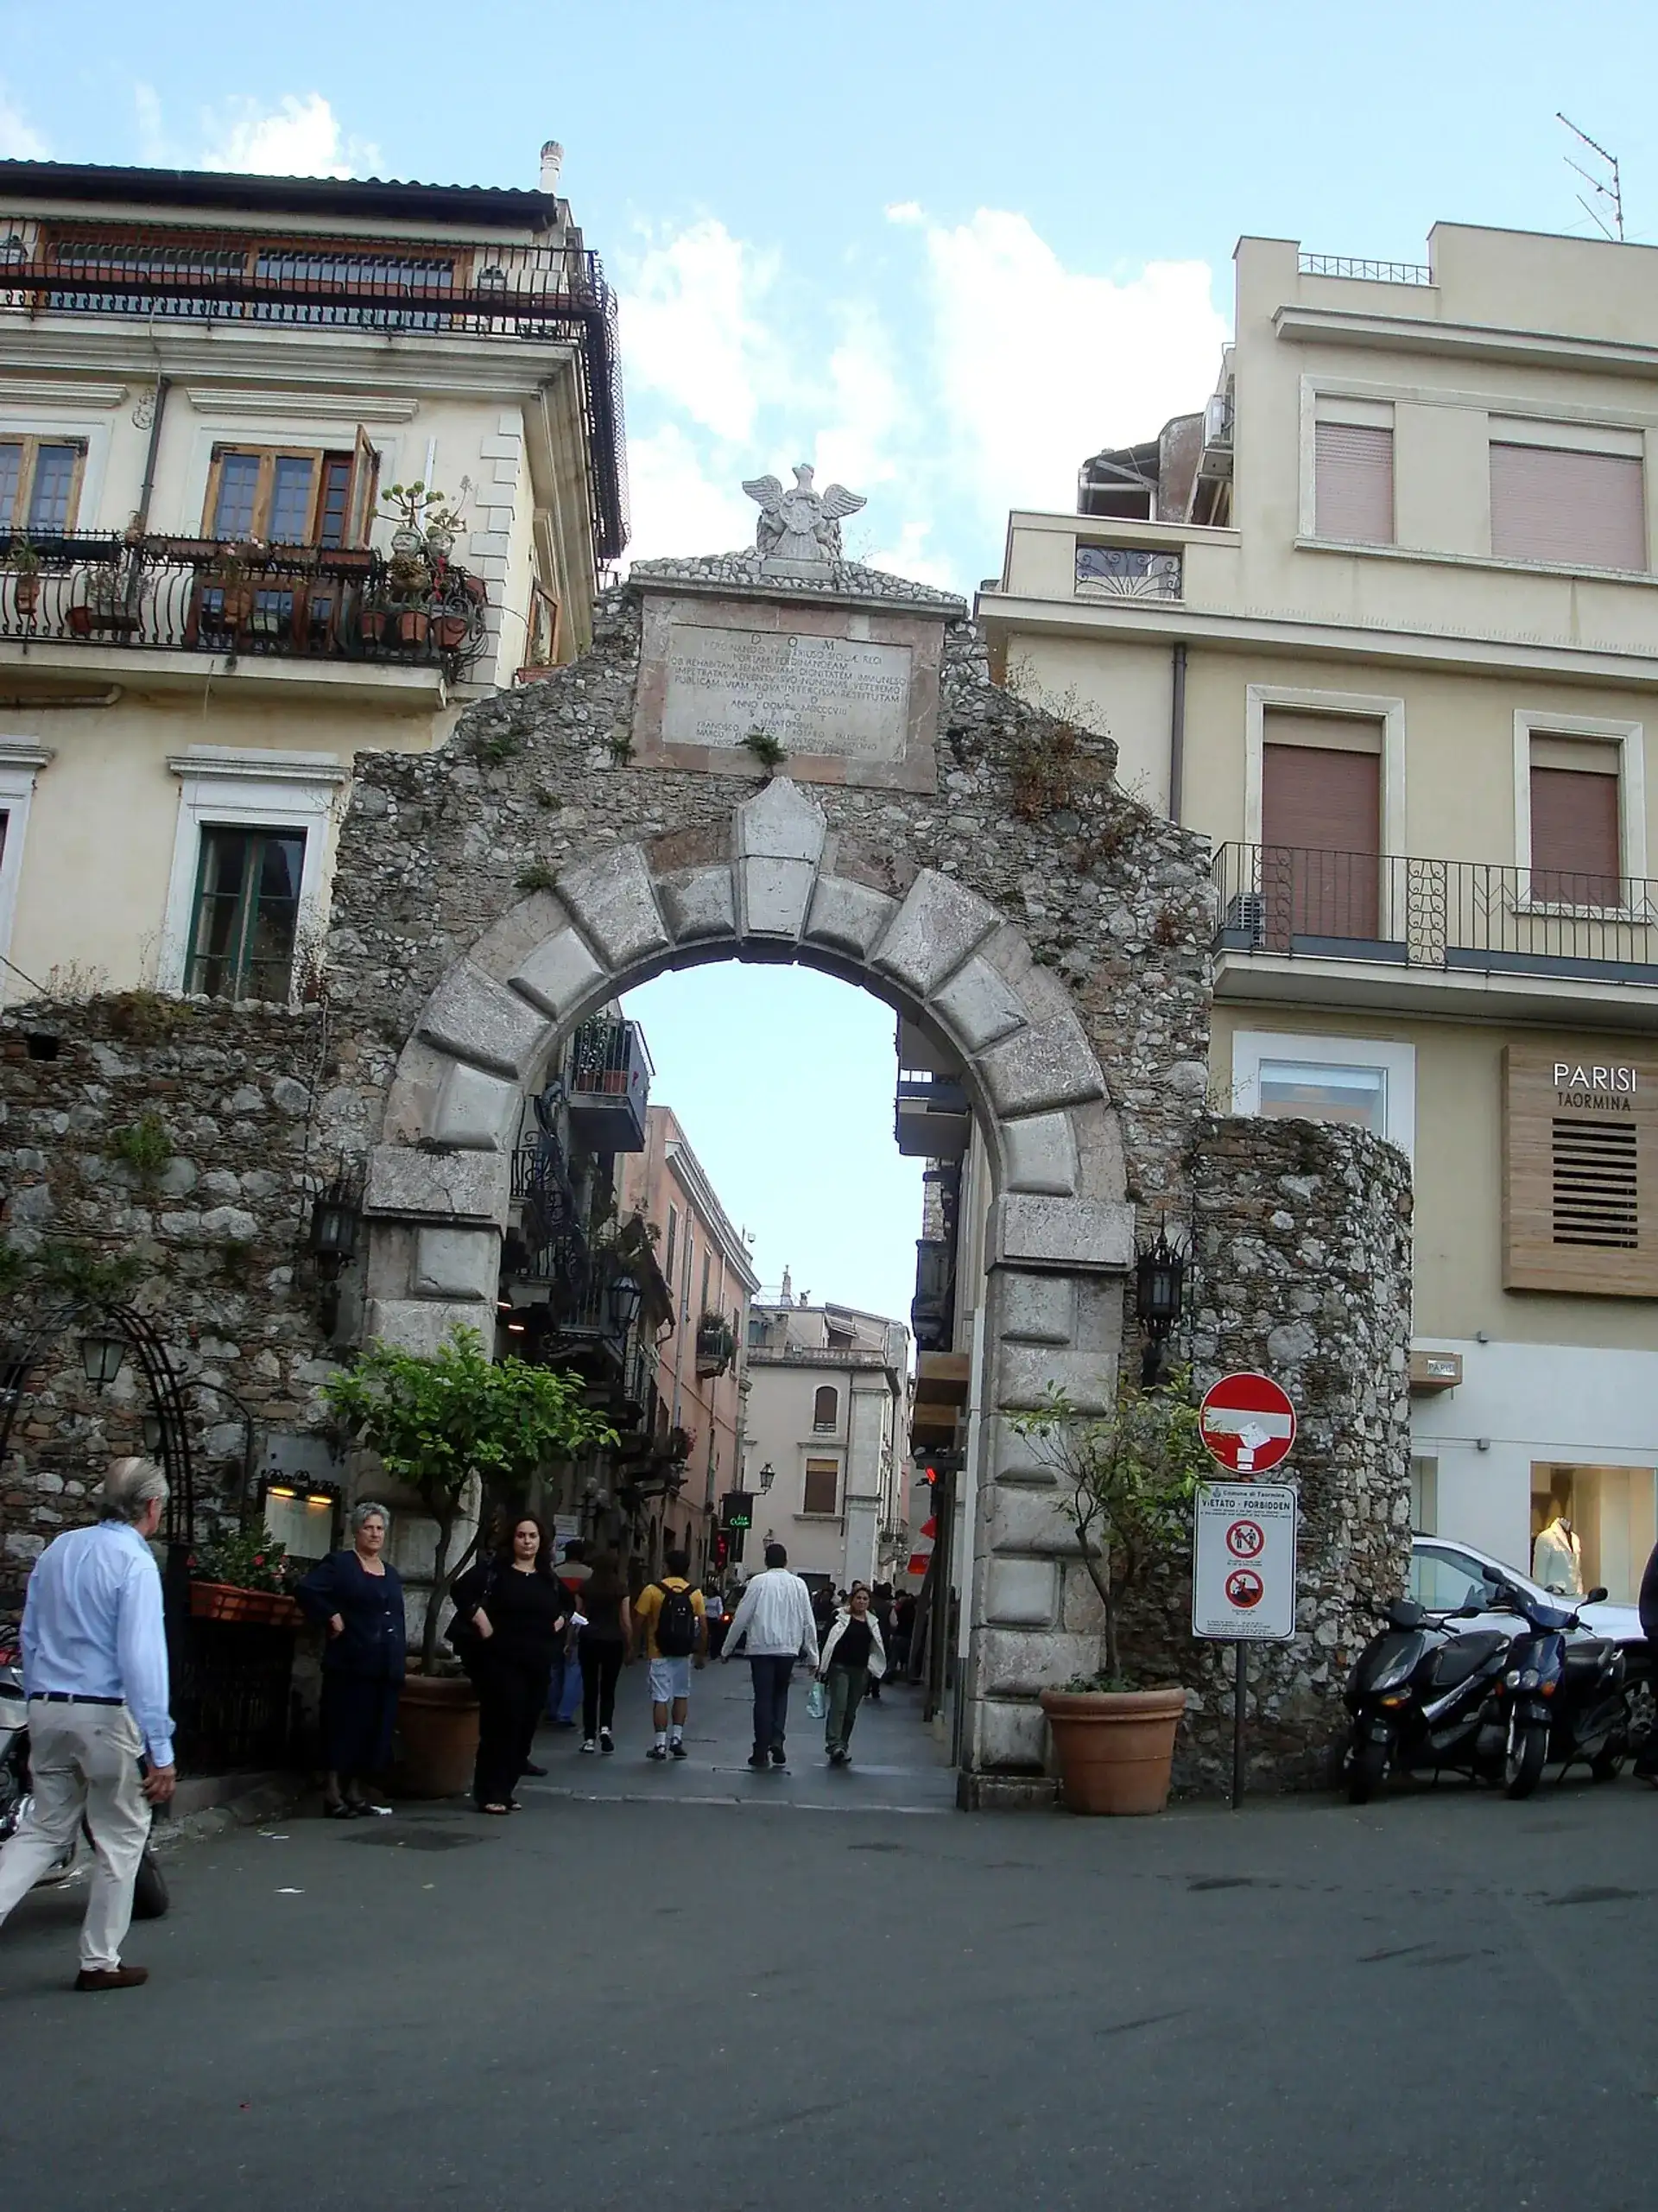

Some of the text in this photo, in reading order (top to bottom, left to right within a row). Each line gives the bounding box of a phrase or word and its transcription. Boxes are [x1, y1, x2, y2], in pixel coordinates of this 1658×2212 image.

[751, 633, 835, 650] D O M
[1552, 1062, 1637, 1093] PARISI
[1557, 1092, 1631, 1112] TAORMINA
[1244, 1500, 1290, 1511] FORBIDDEN
